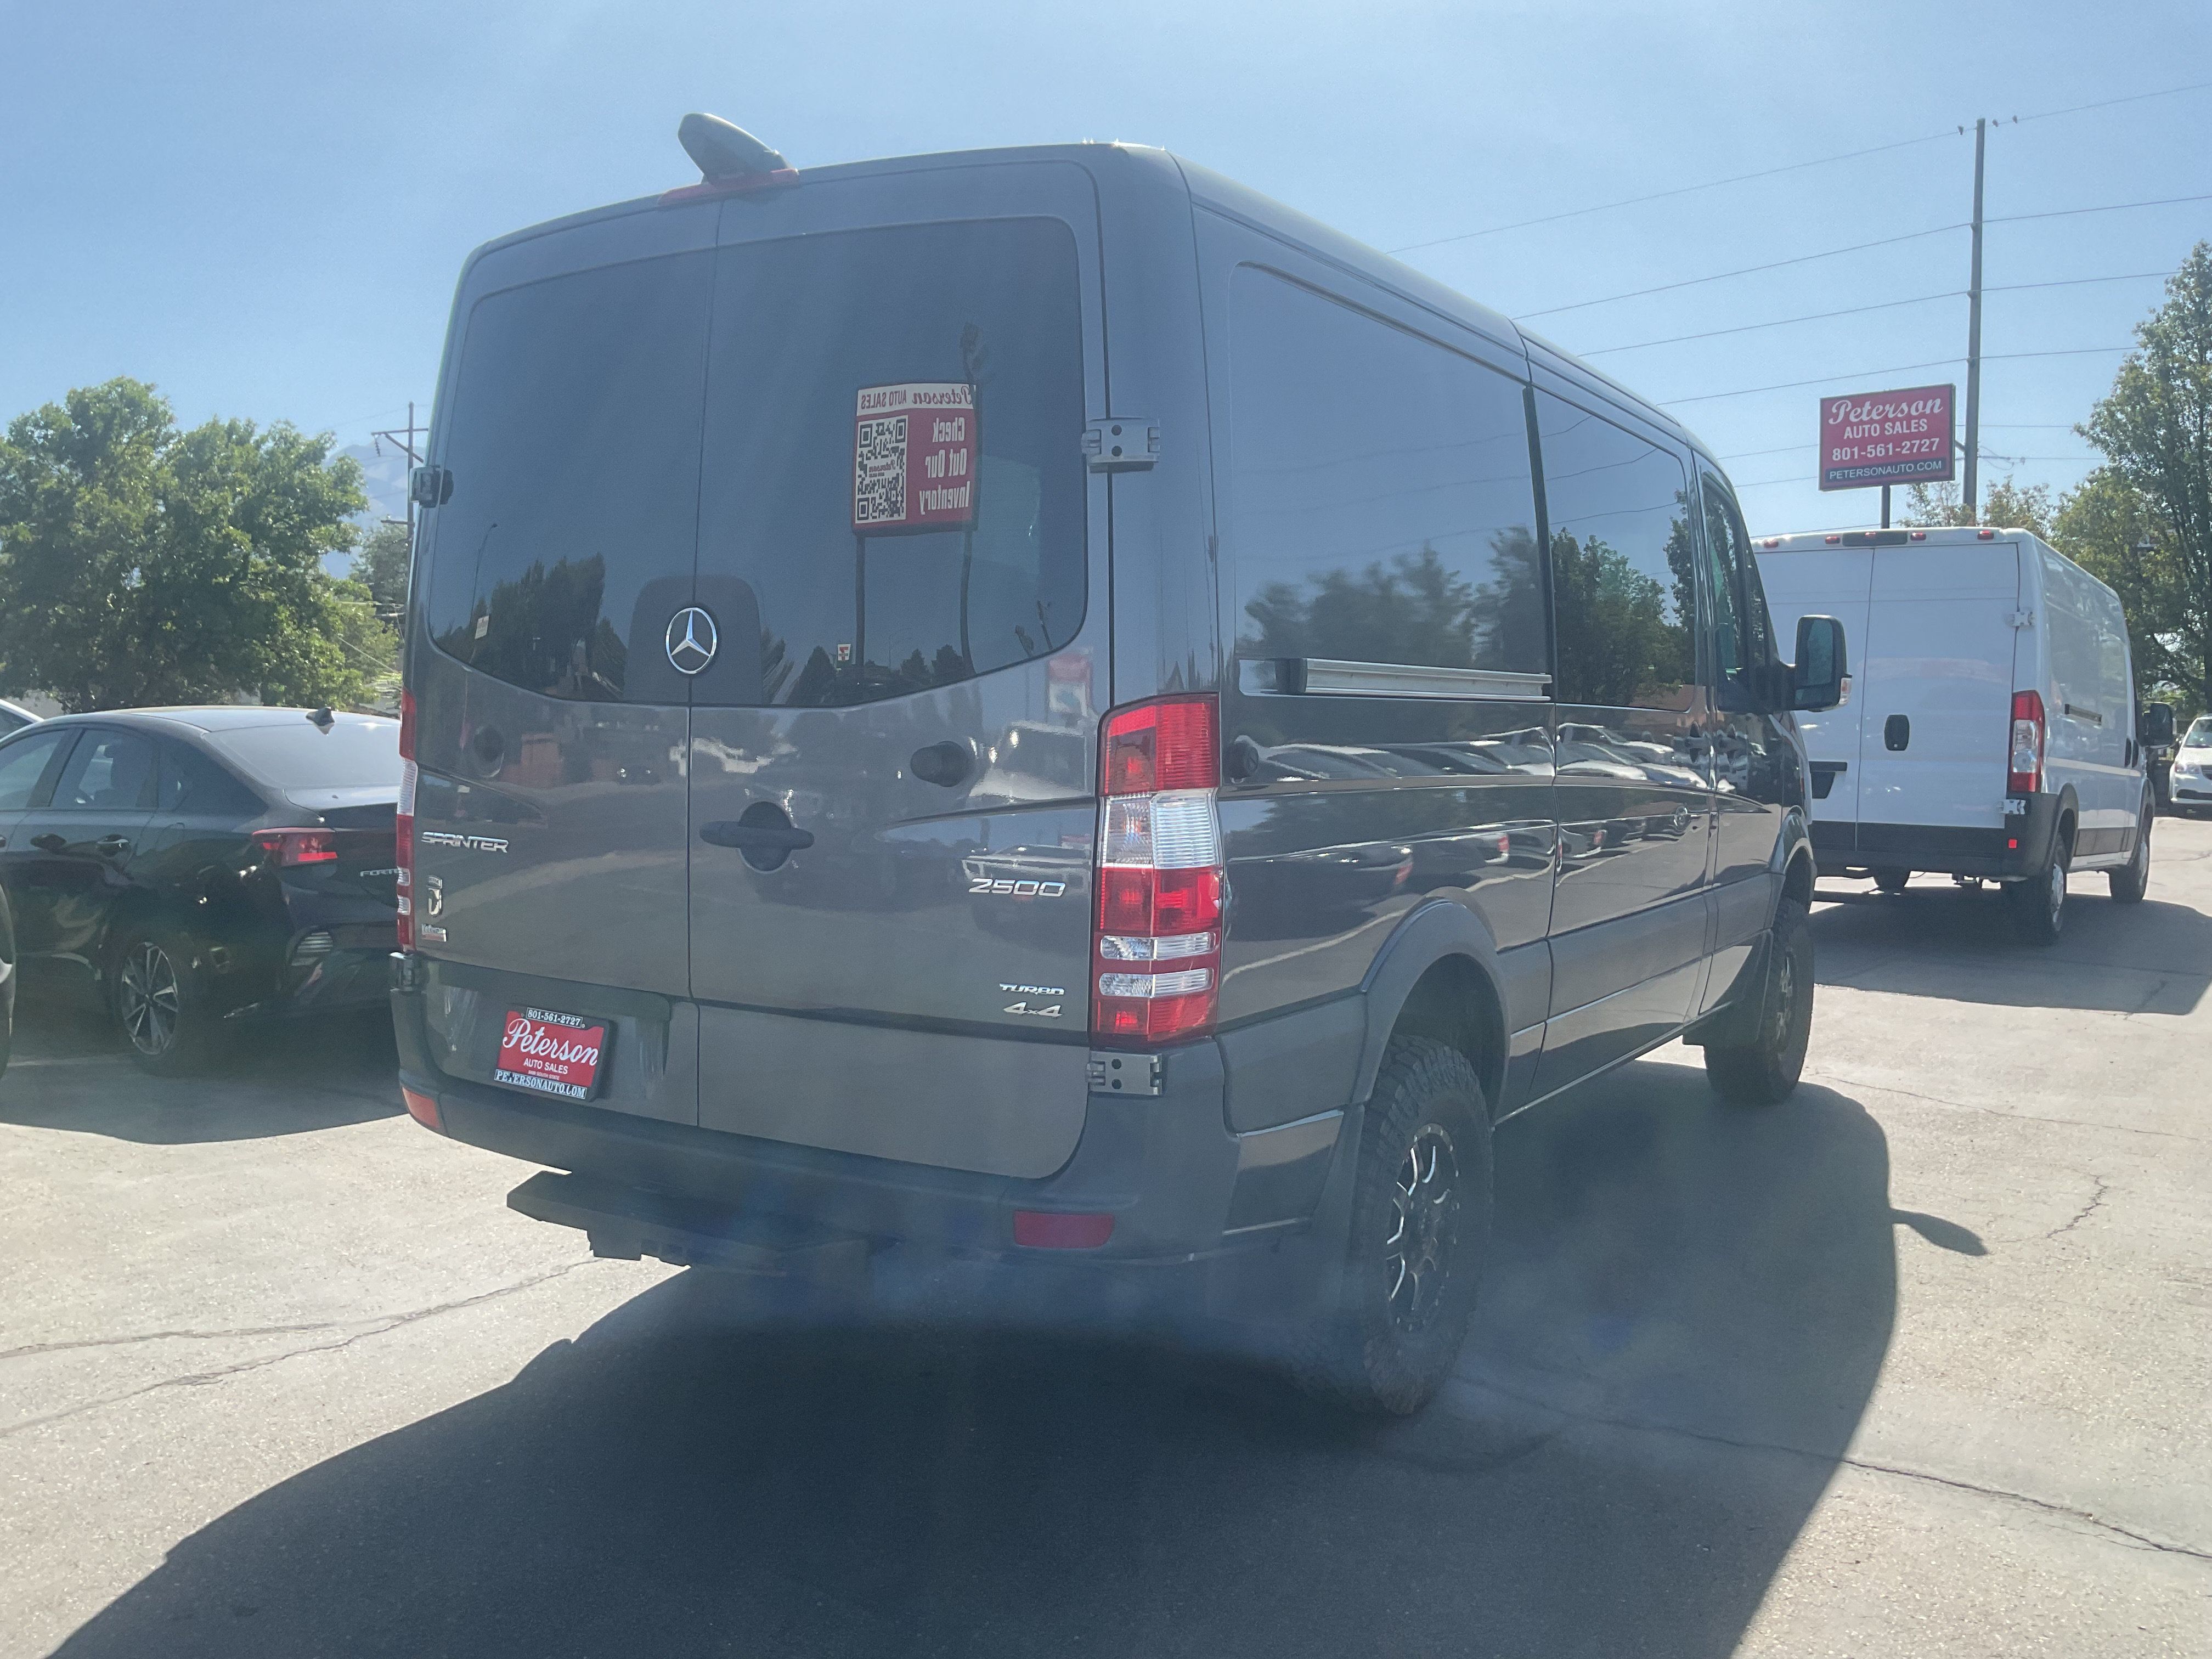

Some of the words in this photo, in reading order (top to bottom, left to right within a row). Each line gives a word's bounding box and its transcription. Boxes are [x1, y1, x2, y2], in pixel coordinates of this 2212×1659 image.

[1828, 398, 1943, 424] Peterson
[1843, 424, 1880, 439] AUTO
[1884, 419, 1927, 435] SALES
[1832, 438, 1939, 461] 801-561-2727
[1829, 461, 1942, 479] PETERSONAUTO.COM
[421, 831, 509, 853] SPRINTER
[968, 878, 1066, 897] 2500
[999, 983, 1065, 995] TURBO
[527, 1009, 581, 1026] 801-561-2727
[503, 1018, 598, 1066] Peterson
[523, 1058, 543, 1069] AUTO
[544, 1062, 568, 1075] SALES
